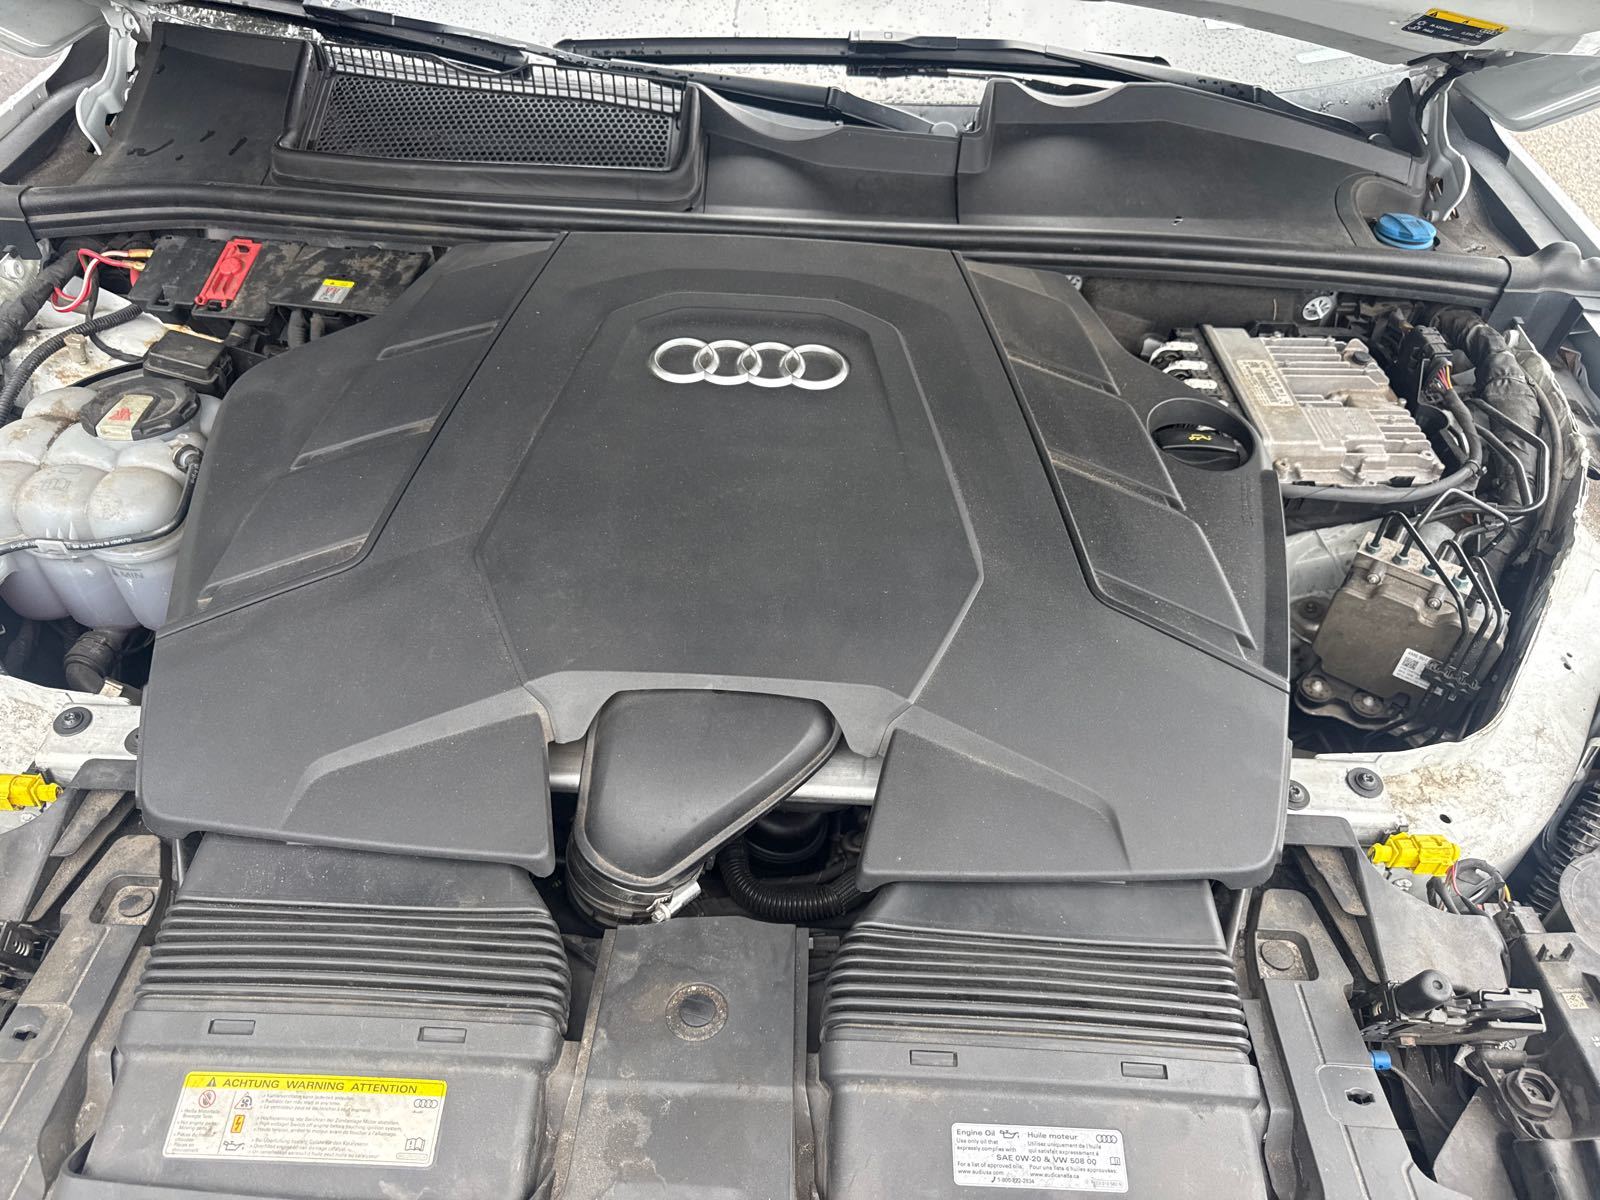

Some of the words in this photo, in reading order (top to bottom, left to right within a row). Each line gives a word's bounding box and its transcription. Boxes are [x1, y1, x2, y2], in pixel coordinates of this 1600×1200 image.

[223, 1079, 280, 1089] ACHTUNG
[286, 1080, 344, 1091] WARNING
[351, 1082, 417, 1093] ATTENTION
